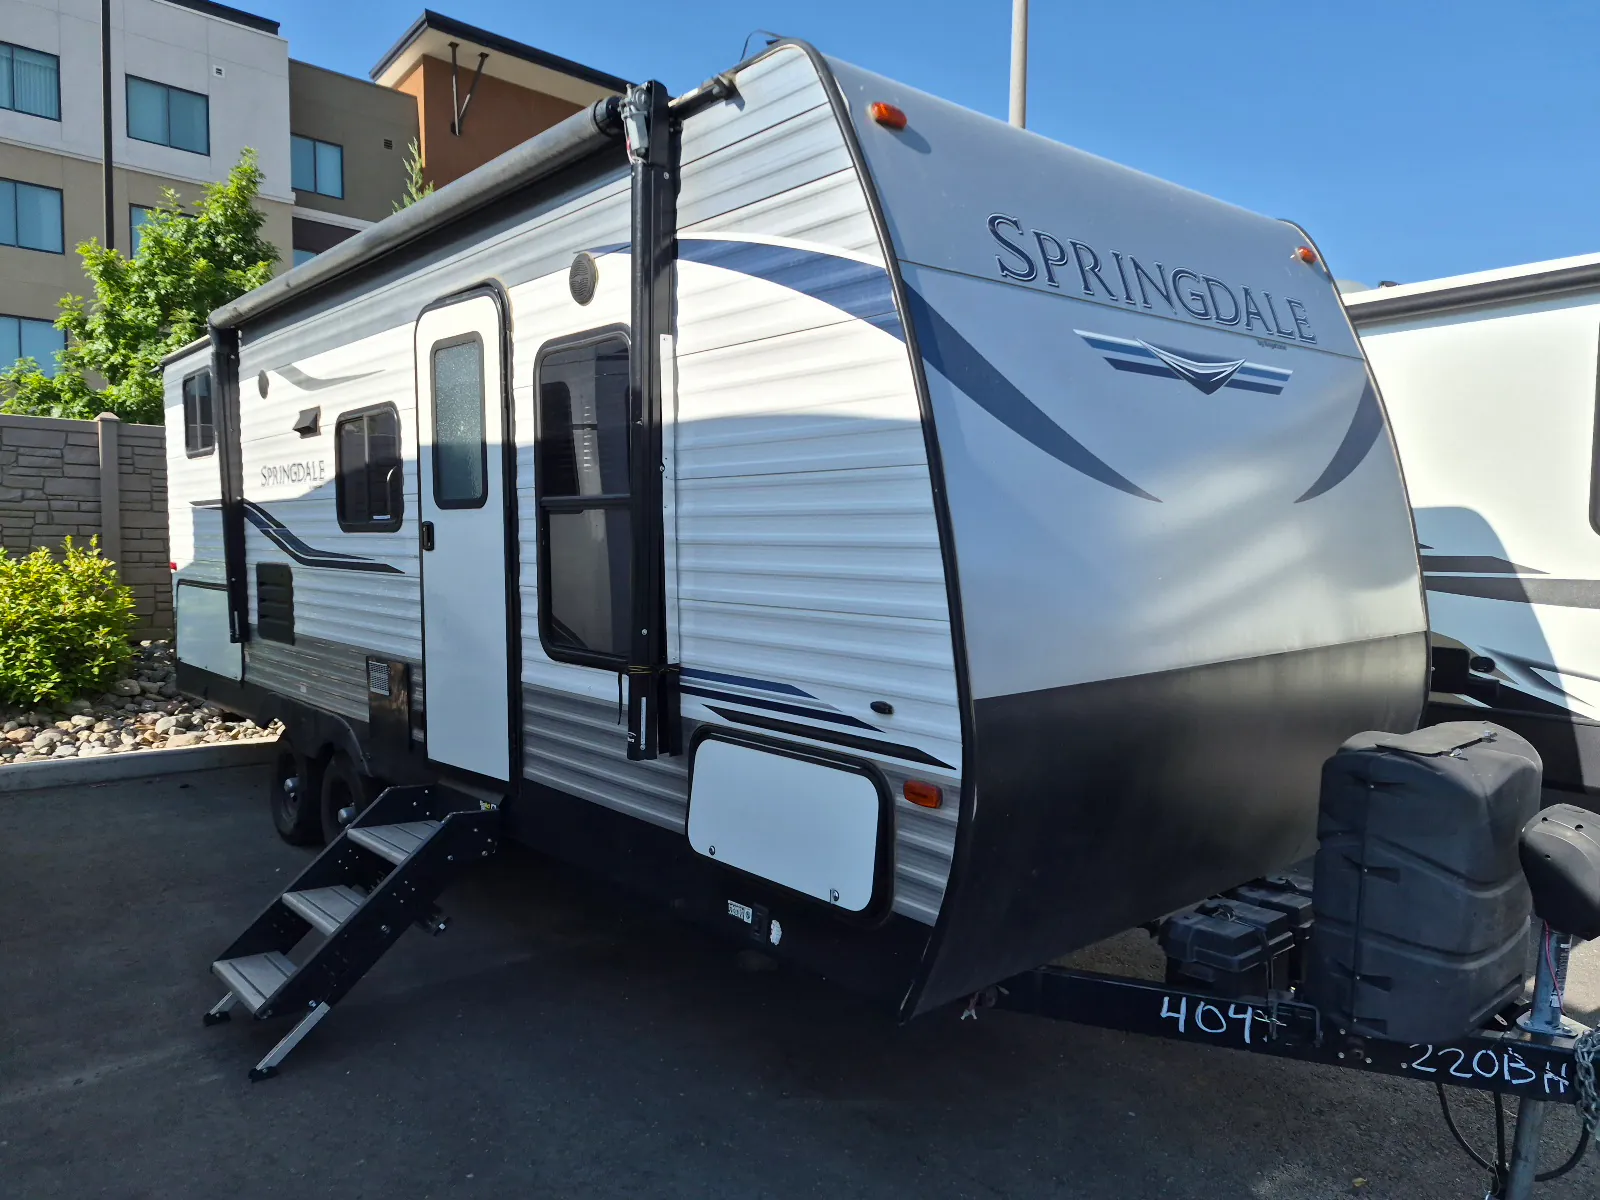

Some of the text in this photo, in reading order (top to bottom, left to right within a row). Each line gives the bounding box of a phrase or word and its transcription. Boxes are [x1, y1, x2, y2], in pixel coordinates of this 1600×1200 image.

[986, 212, 1318, 344] SPRINGDALE
[260, 460, 325, 487] SPRINGDALE
[1160, 996, 1253, 1044] 404
